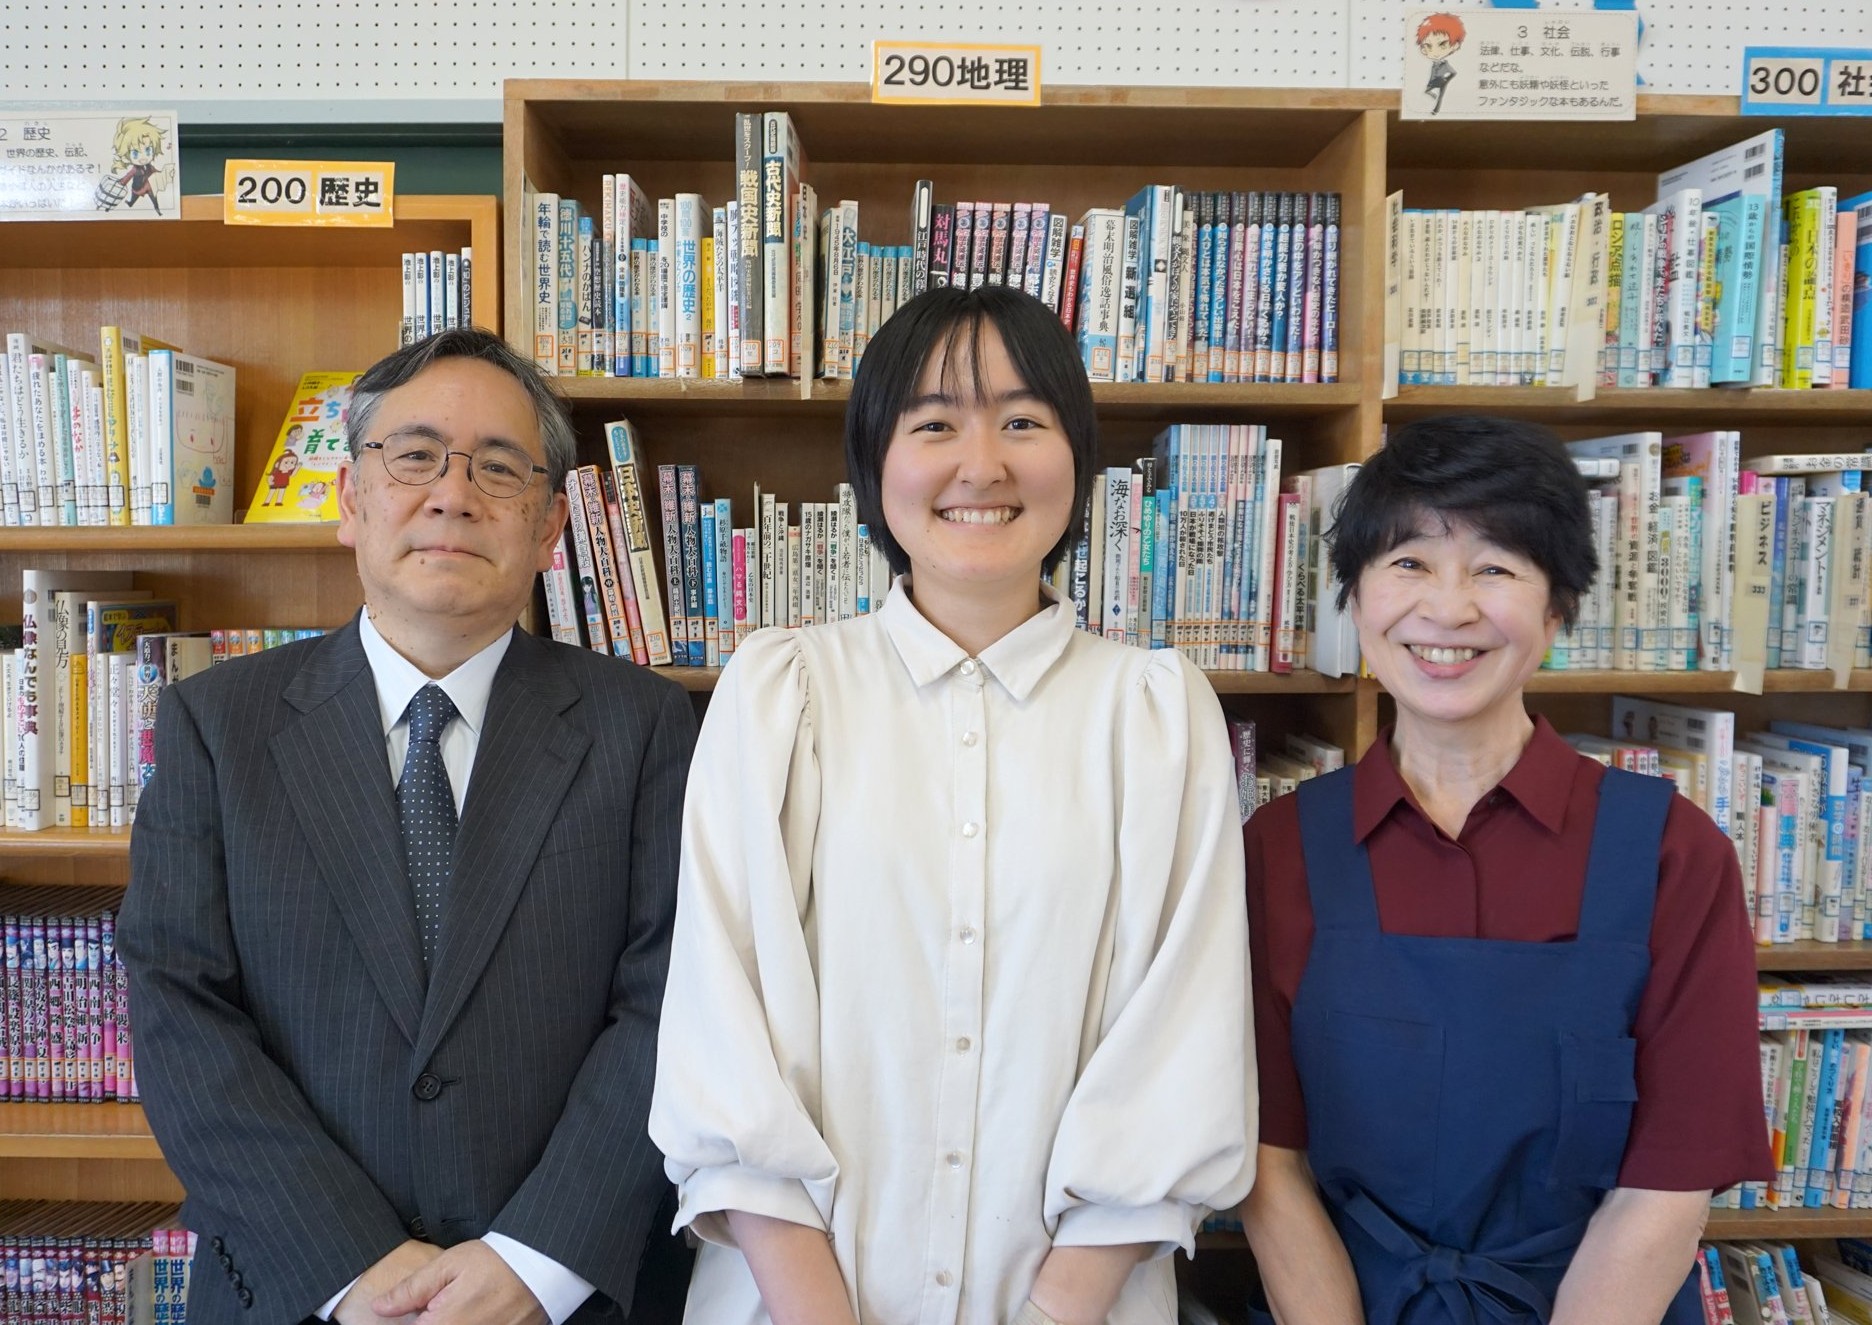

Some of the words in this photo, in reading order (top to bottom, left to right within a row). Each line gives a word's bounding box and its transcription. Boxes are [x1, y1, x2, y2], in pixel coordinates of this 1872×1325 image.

[1518, 25, 1528, 38] 3
[1544, 25, 1570, 39] 社会
[884, 54, 1029, 91] 290地理
[1479, 62, 1524, 73] などだな。
[1751, 66, 1819, 96] 300
[1838, 65, 1872, 97] 社
[0, 128, 8, 141] 2
[23, 127, 51, 141] 歴史
[1478, 96, 1623, 107] ファンタジックな本もあるんだ。
[237, 175, 306, 205] 200
[320, 177, 382, 208] 歴史
[740, 169, 759, 257] 戦国史新聞
[765, 159, 782, 237] 古代史新聞
[537, 202, 551, 304] 年輪で読む世界史
[841, 226, 857, 277] 大江戸
[933, 213, 951, 264] 対馬丸
[1049, 217, 1064, 258] 図解雑学
[1127, 219, 1139, 260] 図解雑学
[1742, 202, 1760, 280] 13歳からの国際情勢
[582, 245, 591, 312] ハンナのかばん
[682, 239, 696, 313] 世界の歴史
[1099, 219, 1116, 333] 幕末明治風俗逸話事典
[1123, 266, 1137, 319] 新選組
[403, 315, 413, 343] 世界の
[12, 353, 30, 459] 君たちはどう生きるか
[804, 511, 812, 568] 15歳のナガサキ原爆
[1109, 479, 1130, 552] 海なお深く
[1142, 500, 1153, 566] ひめゆりの乙女たち
[1187, 511, 1197, 576] 日本が戦場になった日
[1206, 511, 1216, 565] 逃げまどう市民たち
[1216, 511, 1226, 557] 人類初の核攻撃
[1758, 500, 1772, 565] ビジネス
[1815, 501, 1832, 573] マネジメント
[689, 588, 698, 608] 事件編
[735, 567, 745, 614] ハマる縄文!?
[55, 599, 69, 669] 仏像の見方
[23, 614, 38, 735] 仏像なんでも事典
[50, 978, 62, 1044] 西郷隆盛
[77, 977, 88, 1045] 明治維新
[90, 978, 102, 1045] 西南戦争
[104, 970, 115, 1021] 源義経
[116, 976, 129, 1044] 蒙古襲来
[153, 1257, 170, 1325] 世界の歴
[169, 1257, 186, 1325] 世界の歴
